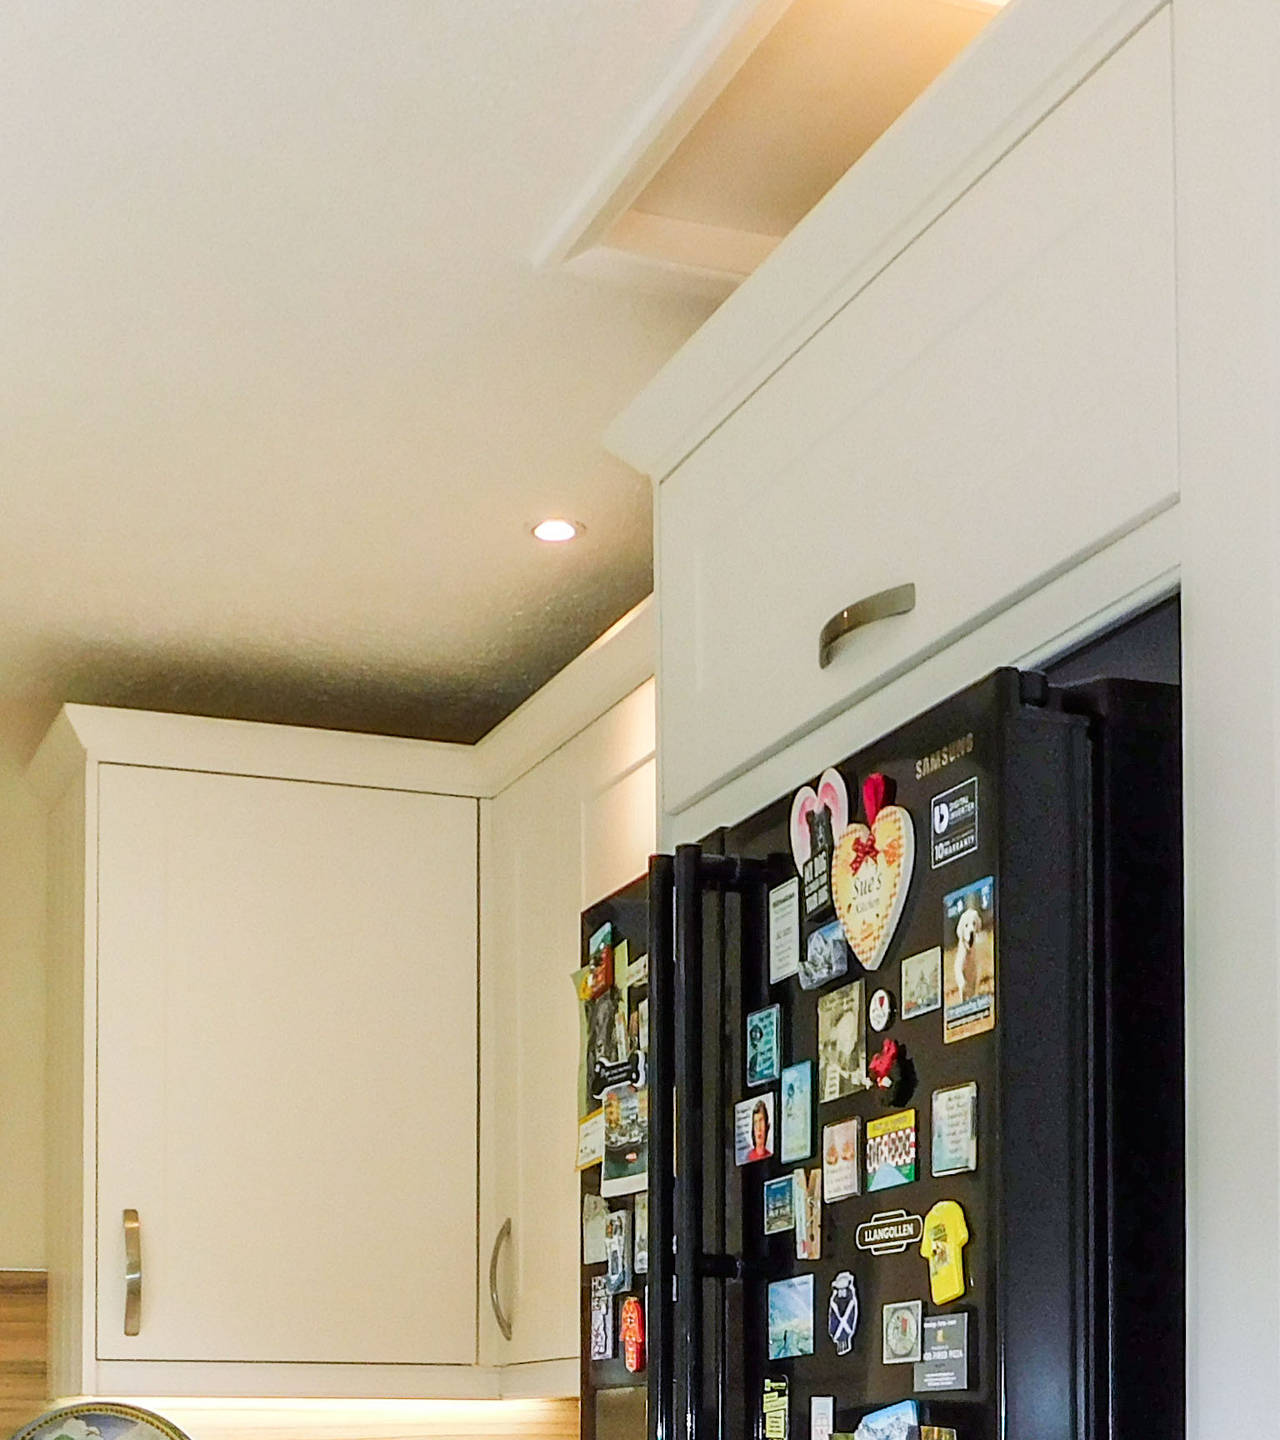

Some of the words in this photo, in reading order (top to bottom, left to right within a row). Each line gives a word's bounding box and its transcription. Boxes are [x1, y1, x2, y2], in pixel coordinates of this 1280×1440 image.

[915, 732, 974, 780] SAMSUNG
[852, 873, 882, 900] Sue's
[864, 1222, 914, 1243] LLANGOLLEN
